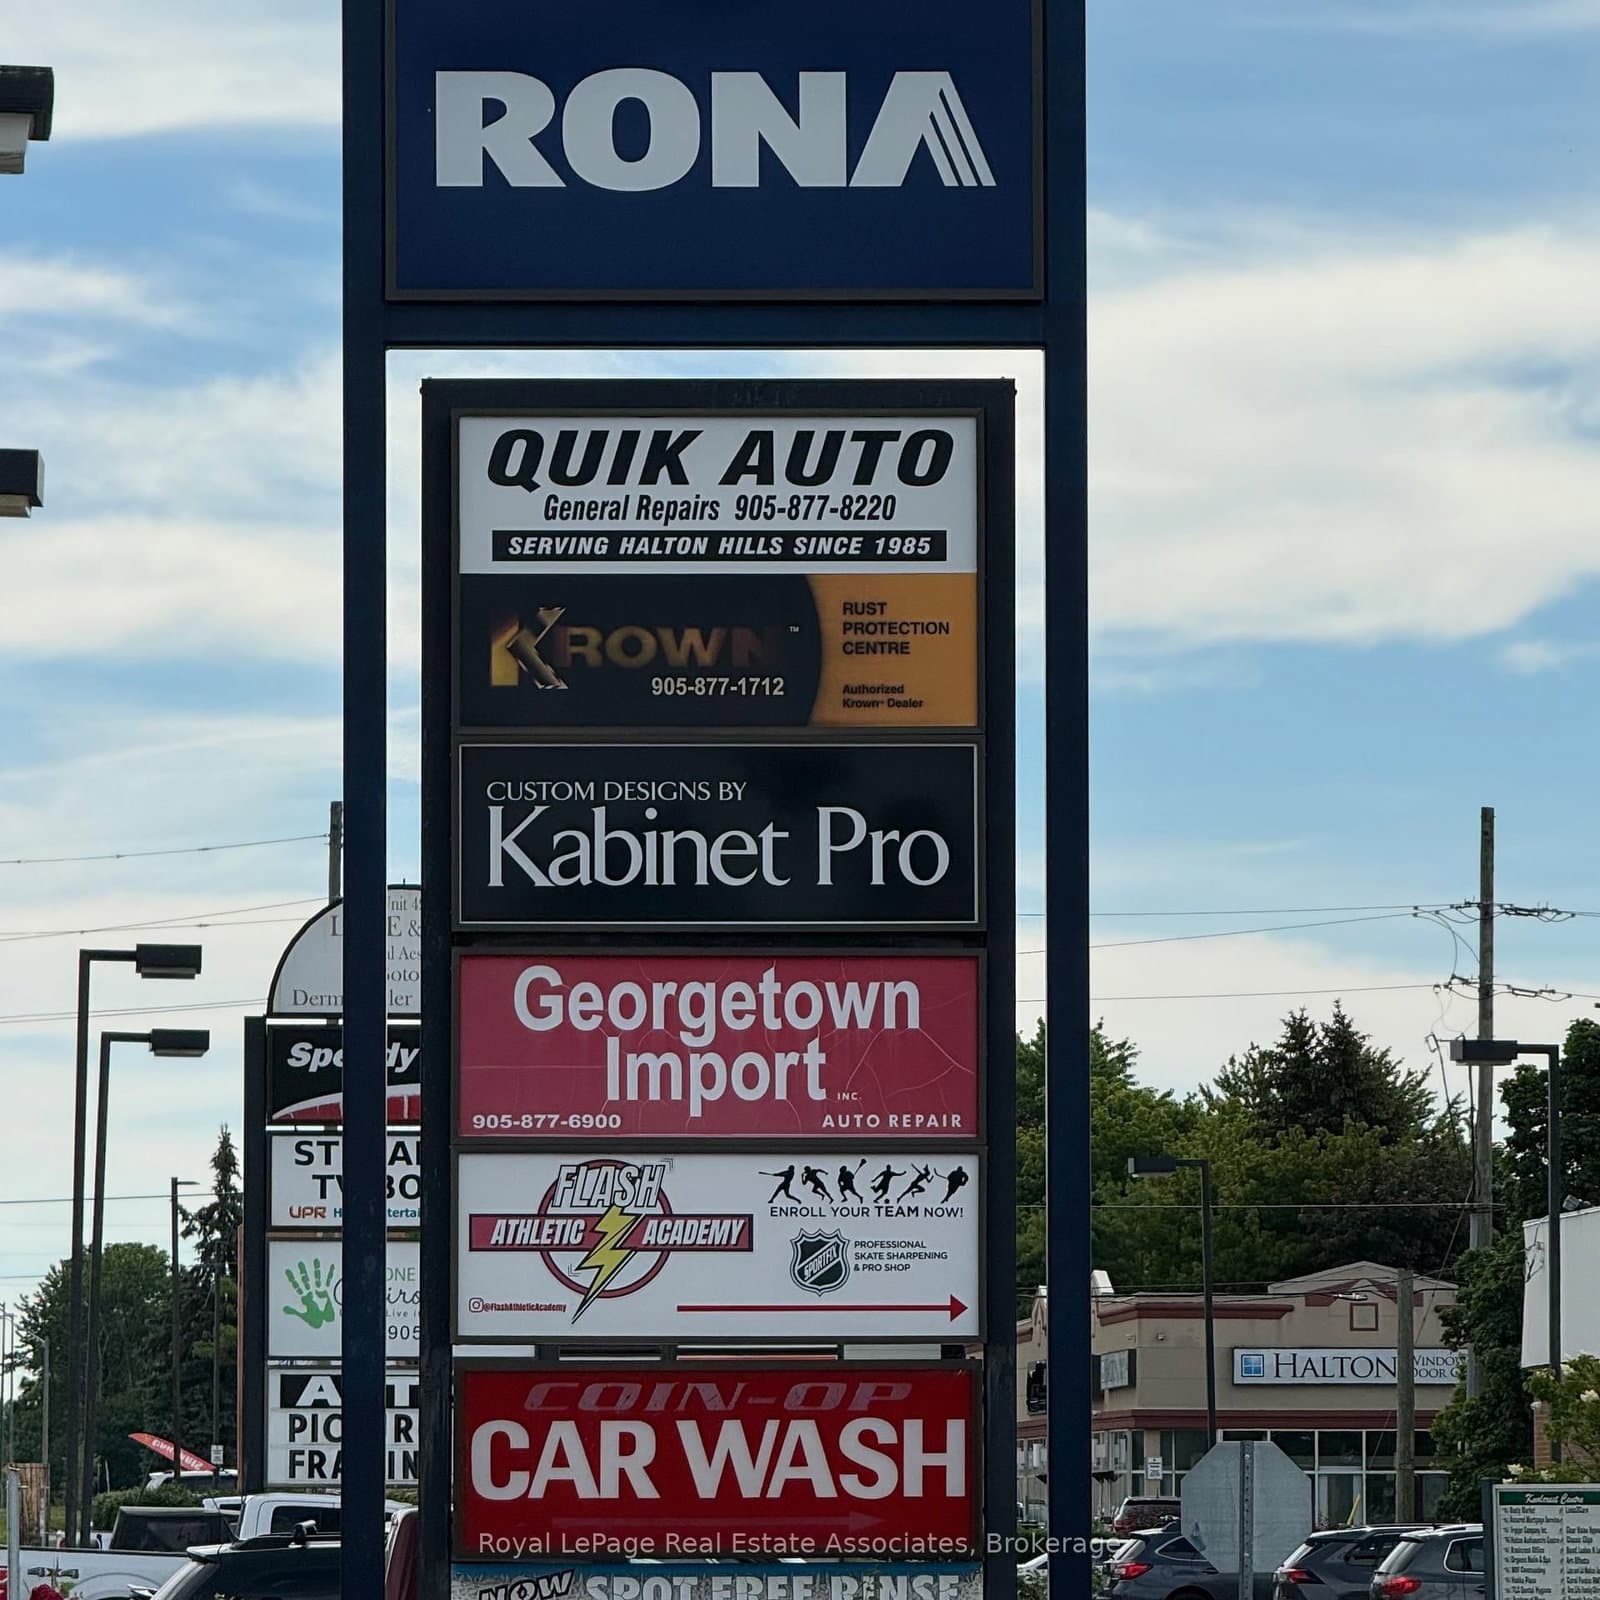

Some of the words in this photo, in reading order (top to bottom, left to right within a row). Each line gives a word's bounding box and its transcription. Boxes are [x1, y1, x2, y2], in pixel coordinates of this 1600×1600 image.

[436, 67, 997, 192] RONA
[487, 428, 704, 494] QUIK
[718, 428, 953, 487] AUTO
[543, 494, 628, 521] General
[635, 494, 720, 526] Repairs
[734, 494, 897, 521] 905-877-8220
[508, 536, 609, 556] SERVING
[618, 536, 713, 556] HALTON
[718, 536, 783, 556] HILLS
[793, 536, 863, 556] SINCE
[874, 536, 931, 556] 1985
[842, 602, 887, 615] RUST
[842, 622, 950, 635] PROTECTION
[842, 641, 911, 655] CENTRE
[651, 677, 785, 696] 905-877-1712
[842, 684, 905, 694] Authorized
[887, 698, 924, 708] Dealer
[486, 781, 595, 801] CUSTOM
[604, 781, 711, 801] DESIGNS
[718, 781, 748, 801] BY
[487, 804, 791, 888] Kabinet
[816, 806, 950, 887] Pro
[513, 965, 921, 1047] Georgetown
[606, 1036, 827, 1118] Import
[837, 1092, 862, 1100] INC.
[472, 1114, 622, 1129] 905-877-6900
[822, 1114, 881, 1128] AUTO
[889, 1114, 963, 1128] REPAIR
[551, 1164, 666, 1208] FLASH
[289, 1205, 326, 1219] UPR
[770, 1206, 826, 1218] ENROLL
[831, 1206, 870, 1218] YOUR
[875, 1206, 919, 1218] TEAM
[924, 1206, 964, 1218] NOW!
[490, 1219, 585, 1246] ATHLETIC
[641, 1219, 745, 1246] ACADEMY
[854, 1240, 927, 1249] PROFESSIONAL
[854, 1252, 885, 1260] SKATE
[886, 1252, 948, 1260] SHARPENING
[853, 1264, 860, 1272] &
[862, 1264, 882, 1272] PRO
[884, 1264, 911, 1272] SHOP
[1274, 1353, 1397, 1378] HALTON
[524, 1382, 912, 1412] COIN-OP
[471, 1418, 660, 1501] CAR
[675, 1417, 966, 1500] WASH
